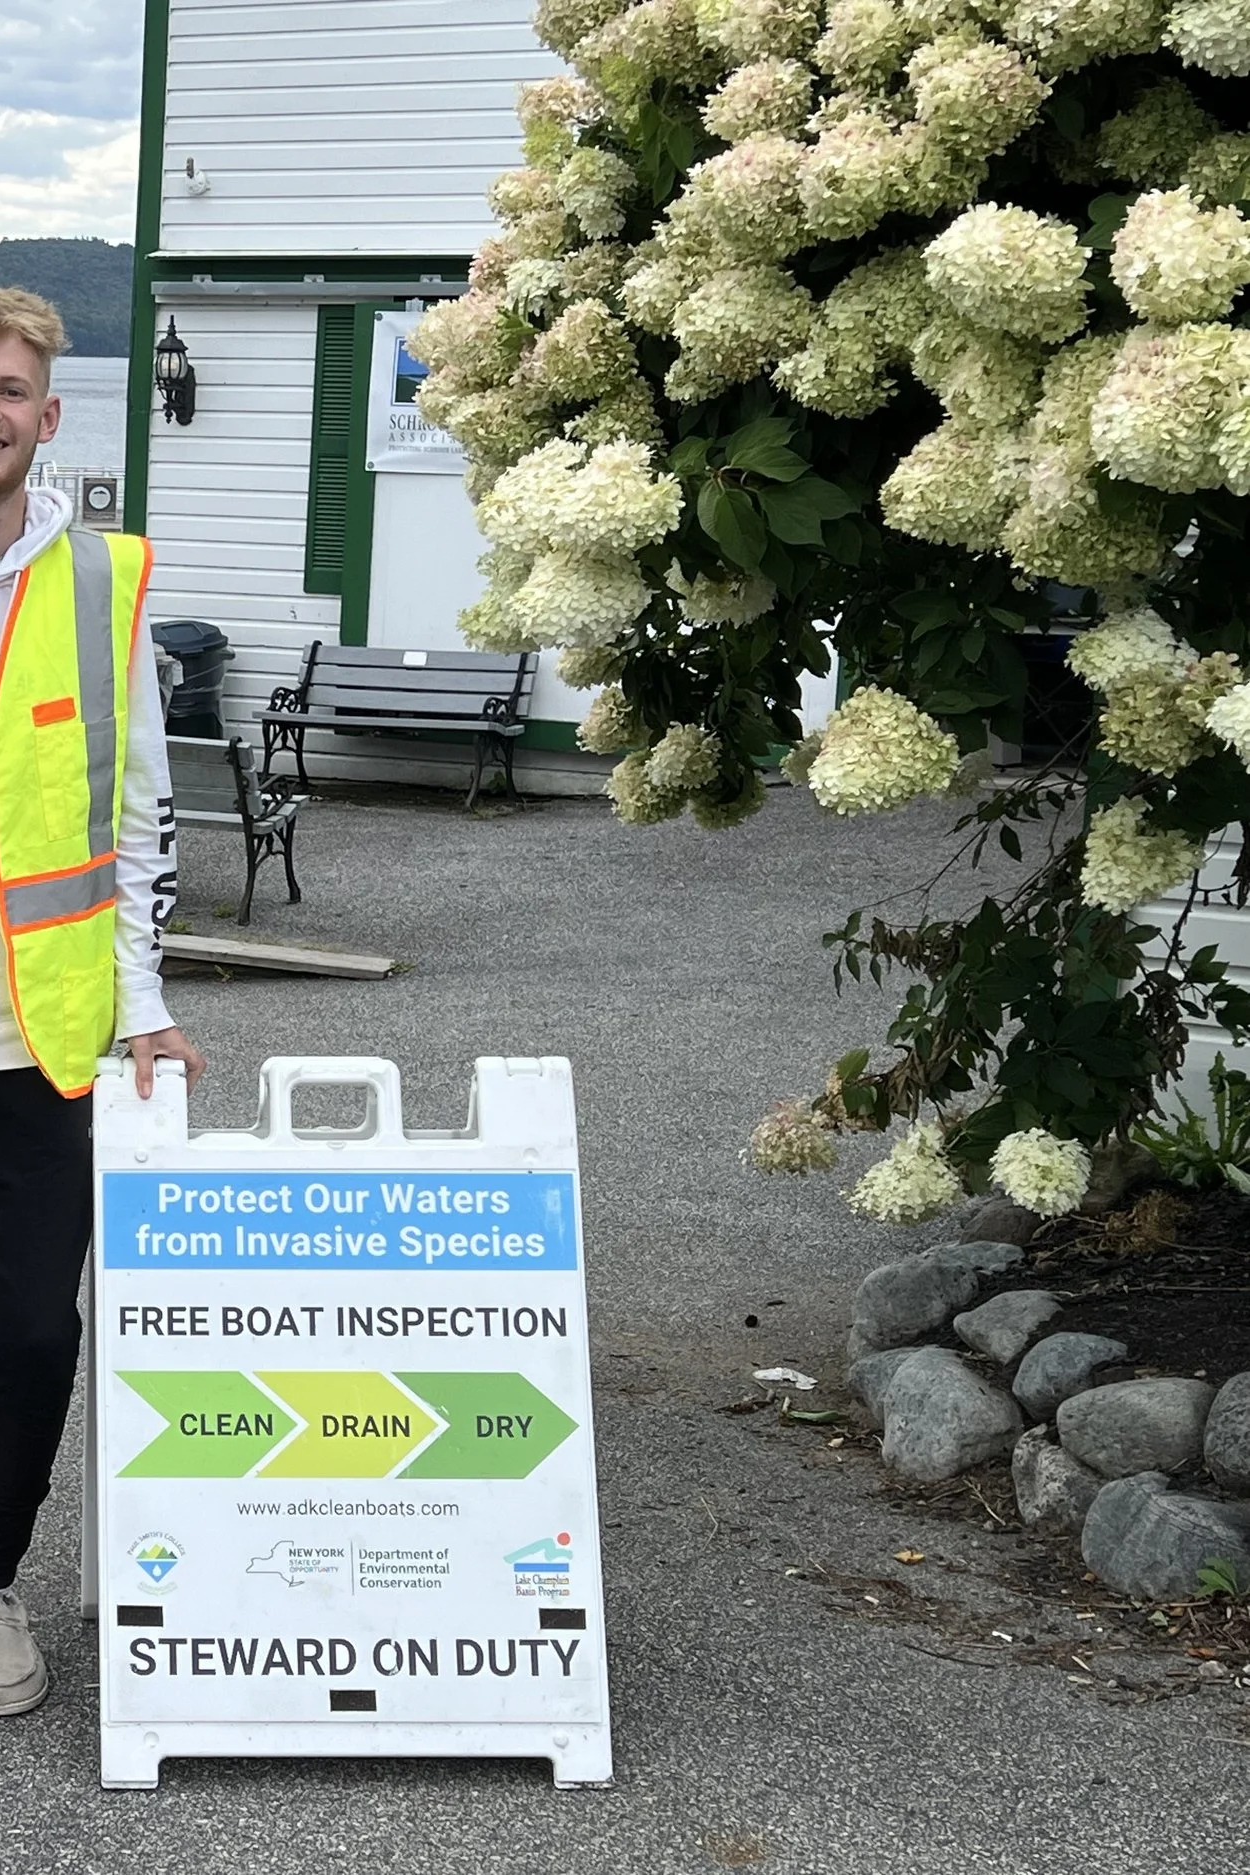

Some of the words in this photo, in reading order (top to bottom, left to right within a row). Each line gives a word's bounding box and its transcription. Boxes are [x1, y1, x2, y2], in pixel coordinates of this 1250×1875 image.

[158, 1182, 293, 1214] Protect
[304, 1183, 369, 1214] Our
[380, 1183, 510, 1214] Waters
[135, 1223, 222, 1256] from
[236, 1224, 387, 1257] Invasive
[399, 1225, 545, 1264] Species
[119, 1306, 210, 1336] FREE
[222, 1306, 324, 1337] BOAT
[337, 1306, 567, 1338] INSPECTION
[180, 1413, 273, 1437] CLEAN
[322, 1415, 410, 1438] DRAIN
[476, 1415, 533, 1438] DRY
[237, 1499, 460, 1517] www.adkcleanboats.com
[288, 1548, 313, 1558] NEW
[315, 1548, 345, 1558] YORK
[359, 1548, 434, 1562] Department
[436, 1548, 449, 1560] of
[359, 1562, 450, 1575] Environmental
[359, 1577, 442, 1589] Conservation
[514, 1574, 531, 1585] Lake
[515, 1586, 536, 1597] Basin
[538, 1586, 570, 1599] Program
[129, 1637, 357, 1676] STEWARD
[373, 1638, 439, 1677] ON
[456, 1638, 581, 1677] DUTY
